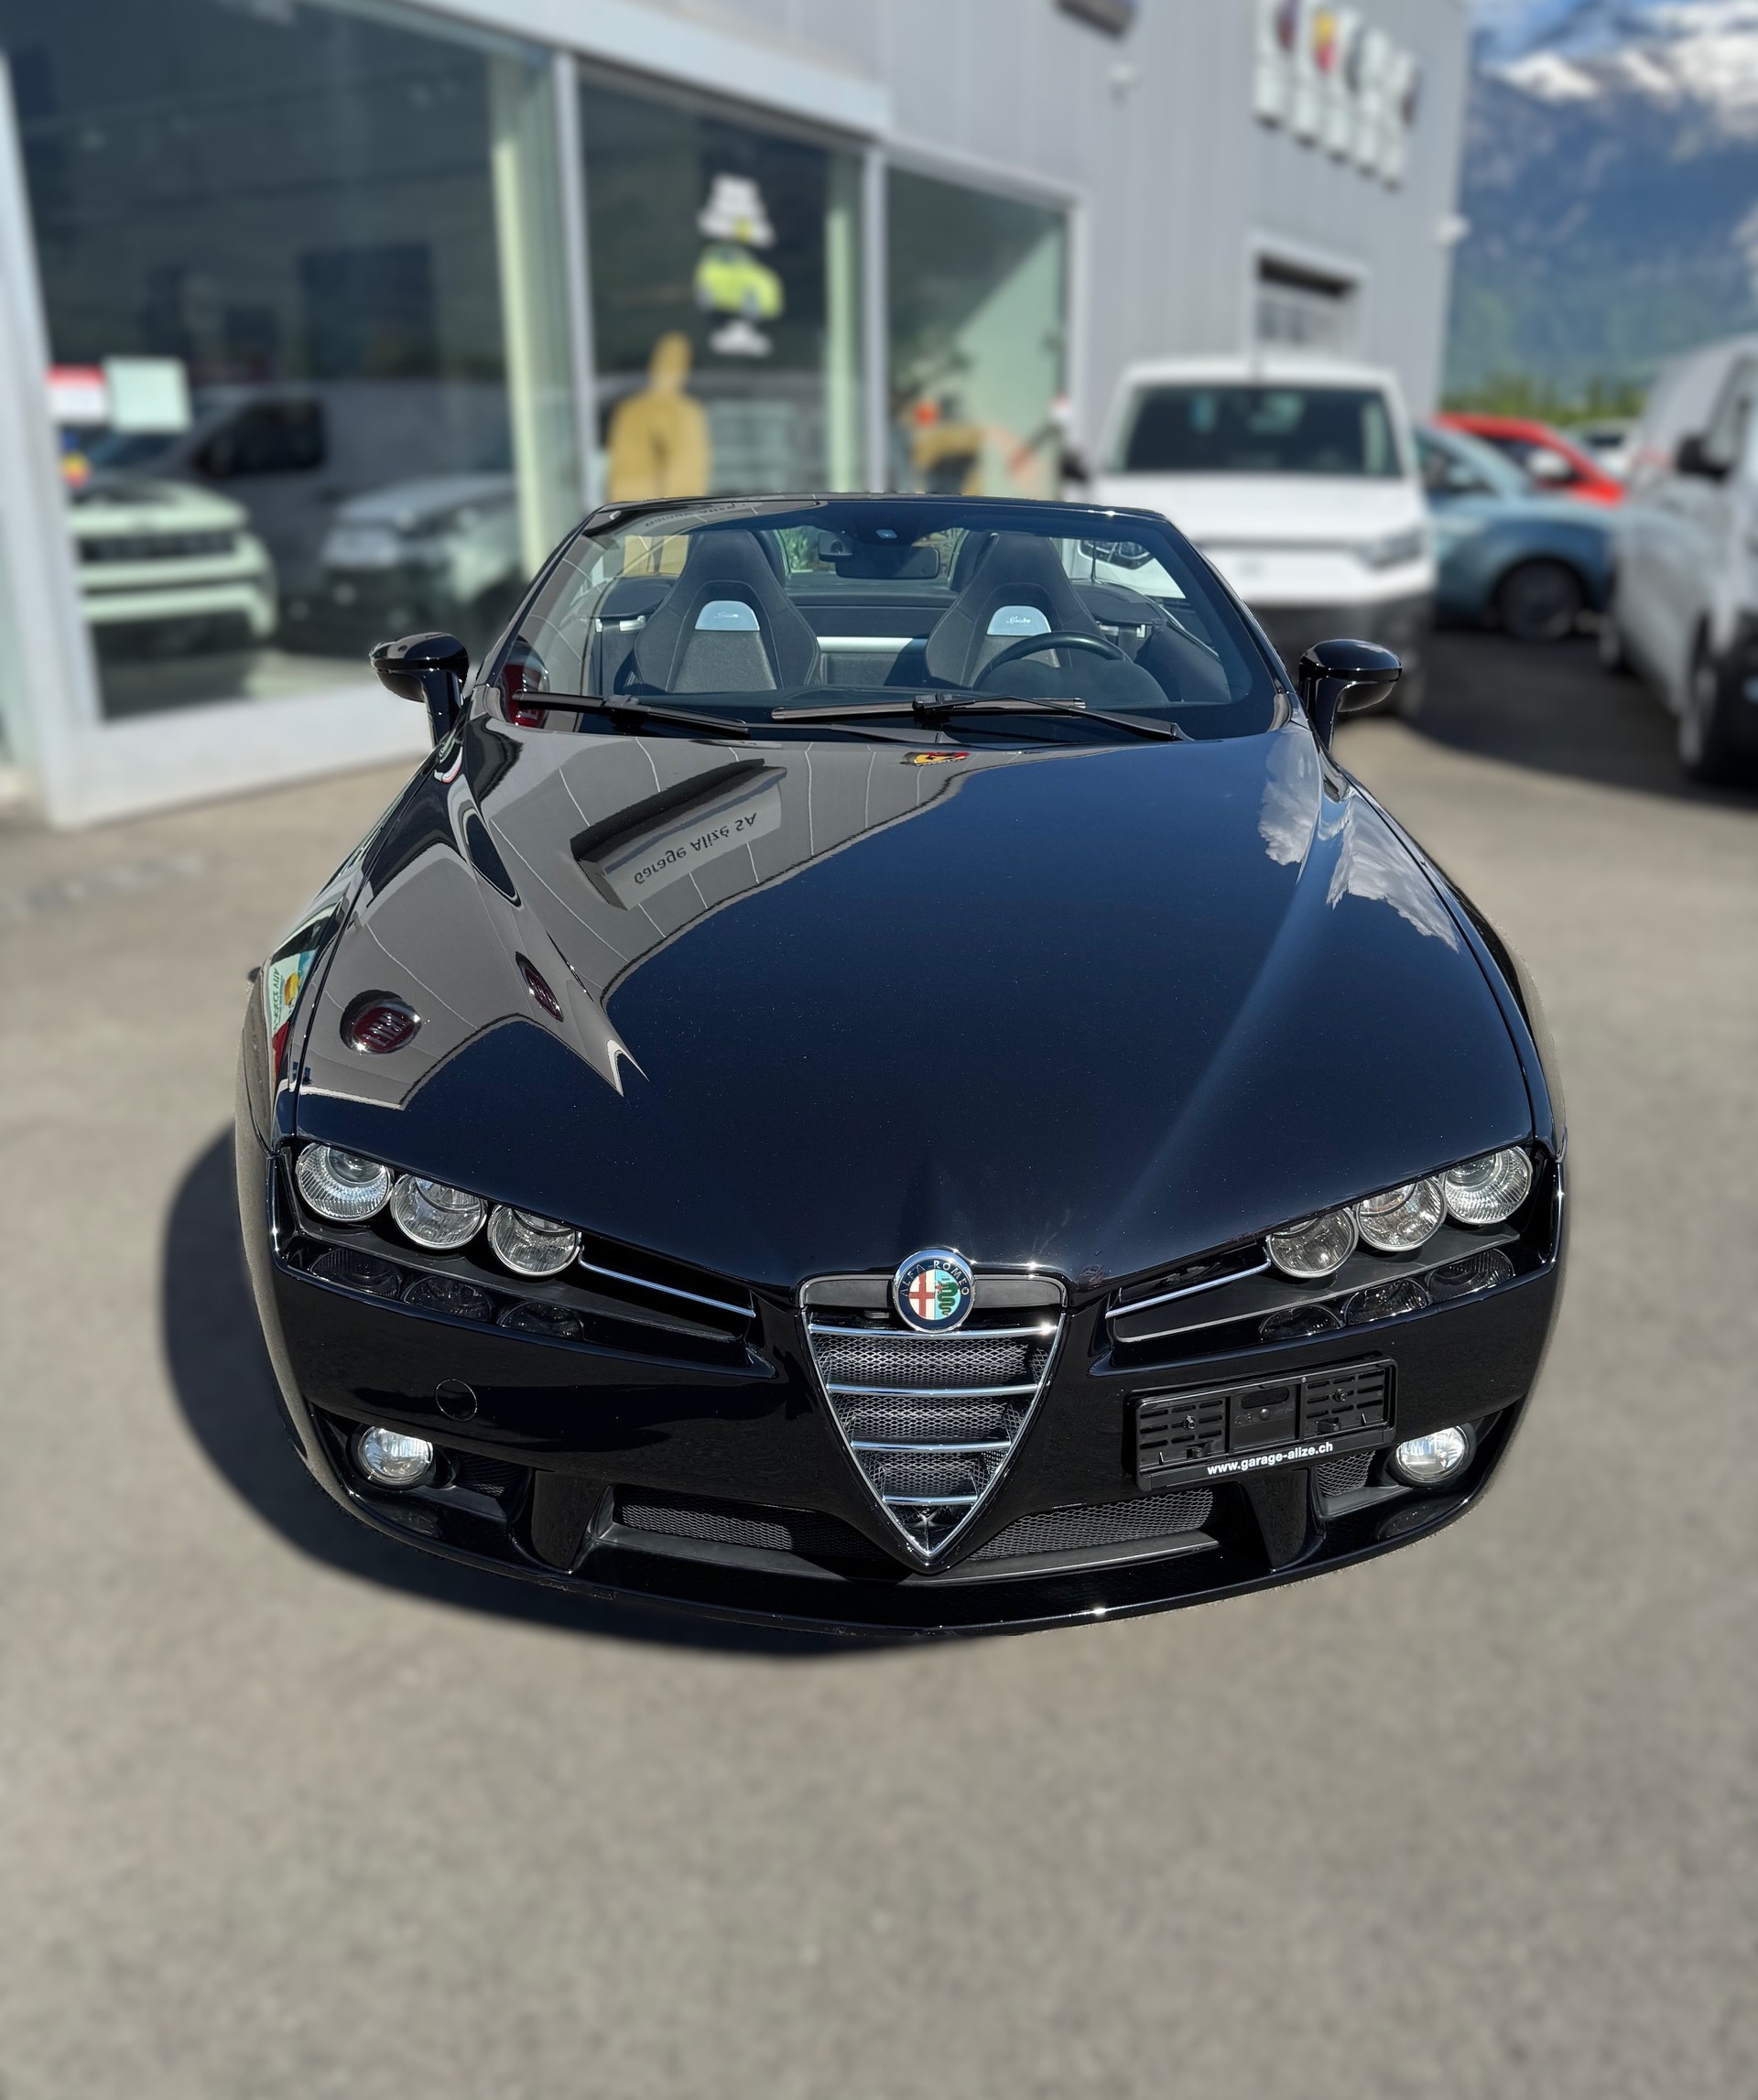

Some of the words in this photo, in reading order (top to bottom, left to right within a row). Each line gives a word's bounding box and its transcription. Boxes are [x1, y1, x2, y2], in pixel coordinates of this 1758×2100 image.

[899, 1263, 926, 1297] ALFA
[933, 1260, 970, 1296] ROMEO
[1207, 1441, 1334, 1475] www.garage-alize.ch
